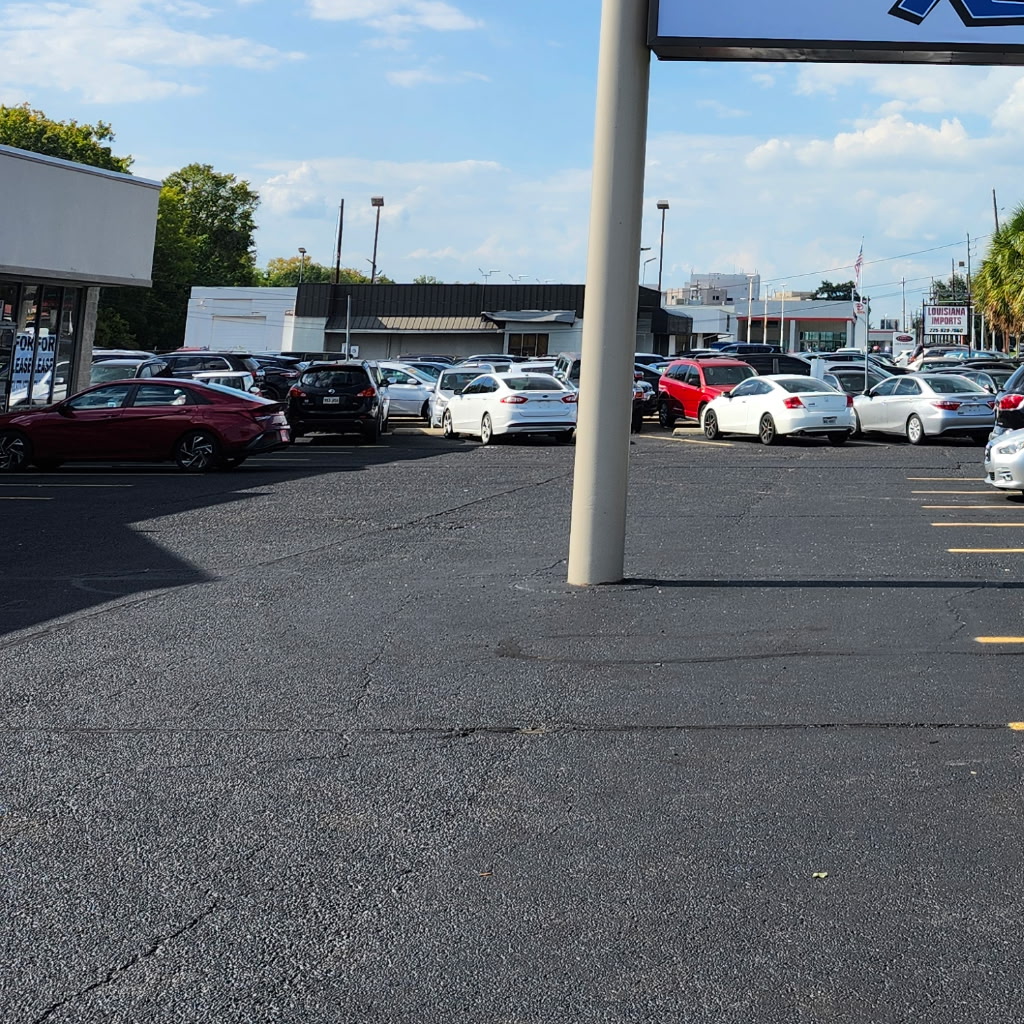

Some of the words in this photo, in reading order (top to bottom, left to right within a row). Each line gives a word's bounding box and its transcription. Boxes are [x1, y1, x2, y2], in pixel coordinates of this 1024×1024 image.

[928, 307, 966, 316] LOUISIANA
[931, 316, 962, 325] IMPORTS
[38, 336, 55, 352] FOR
